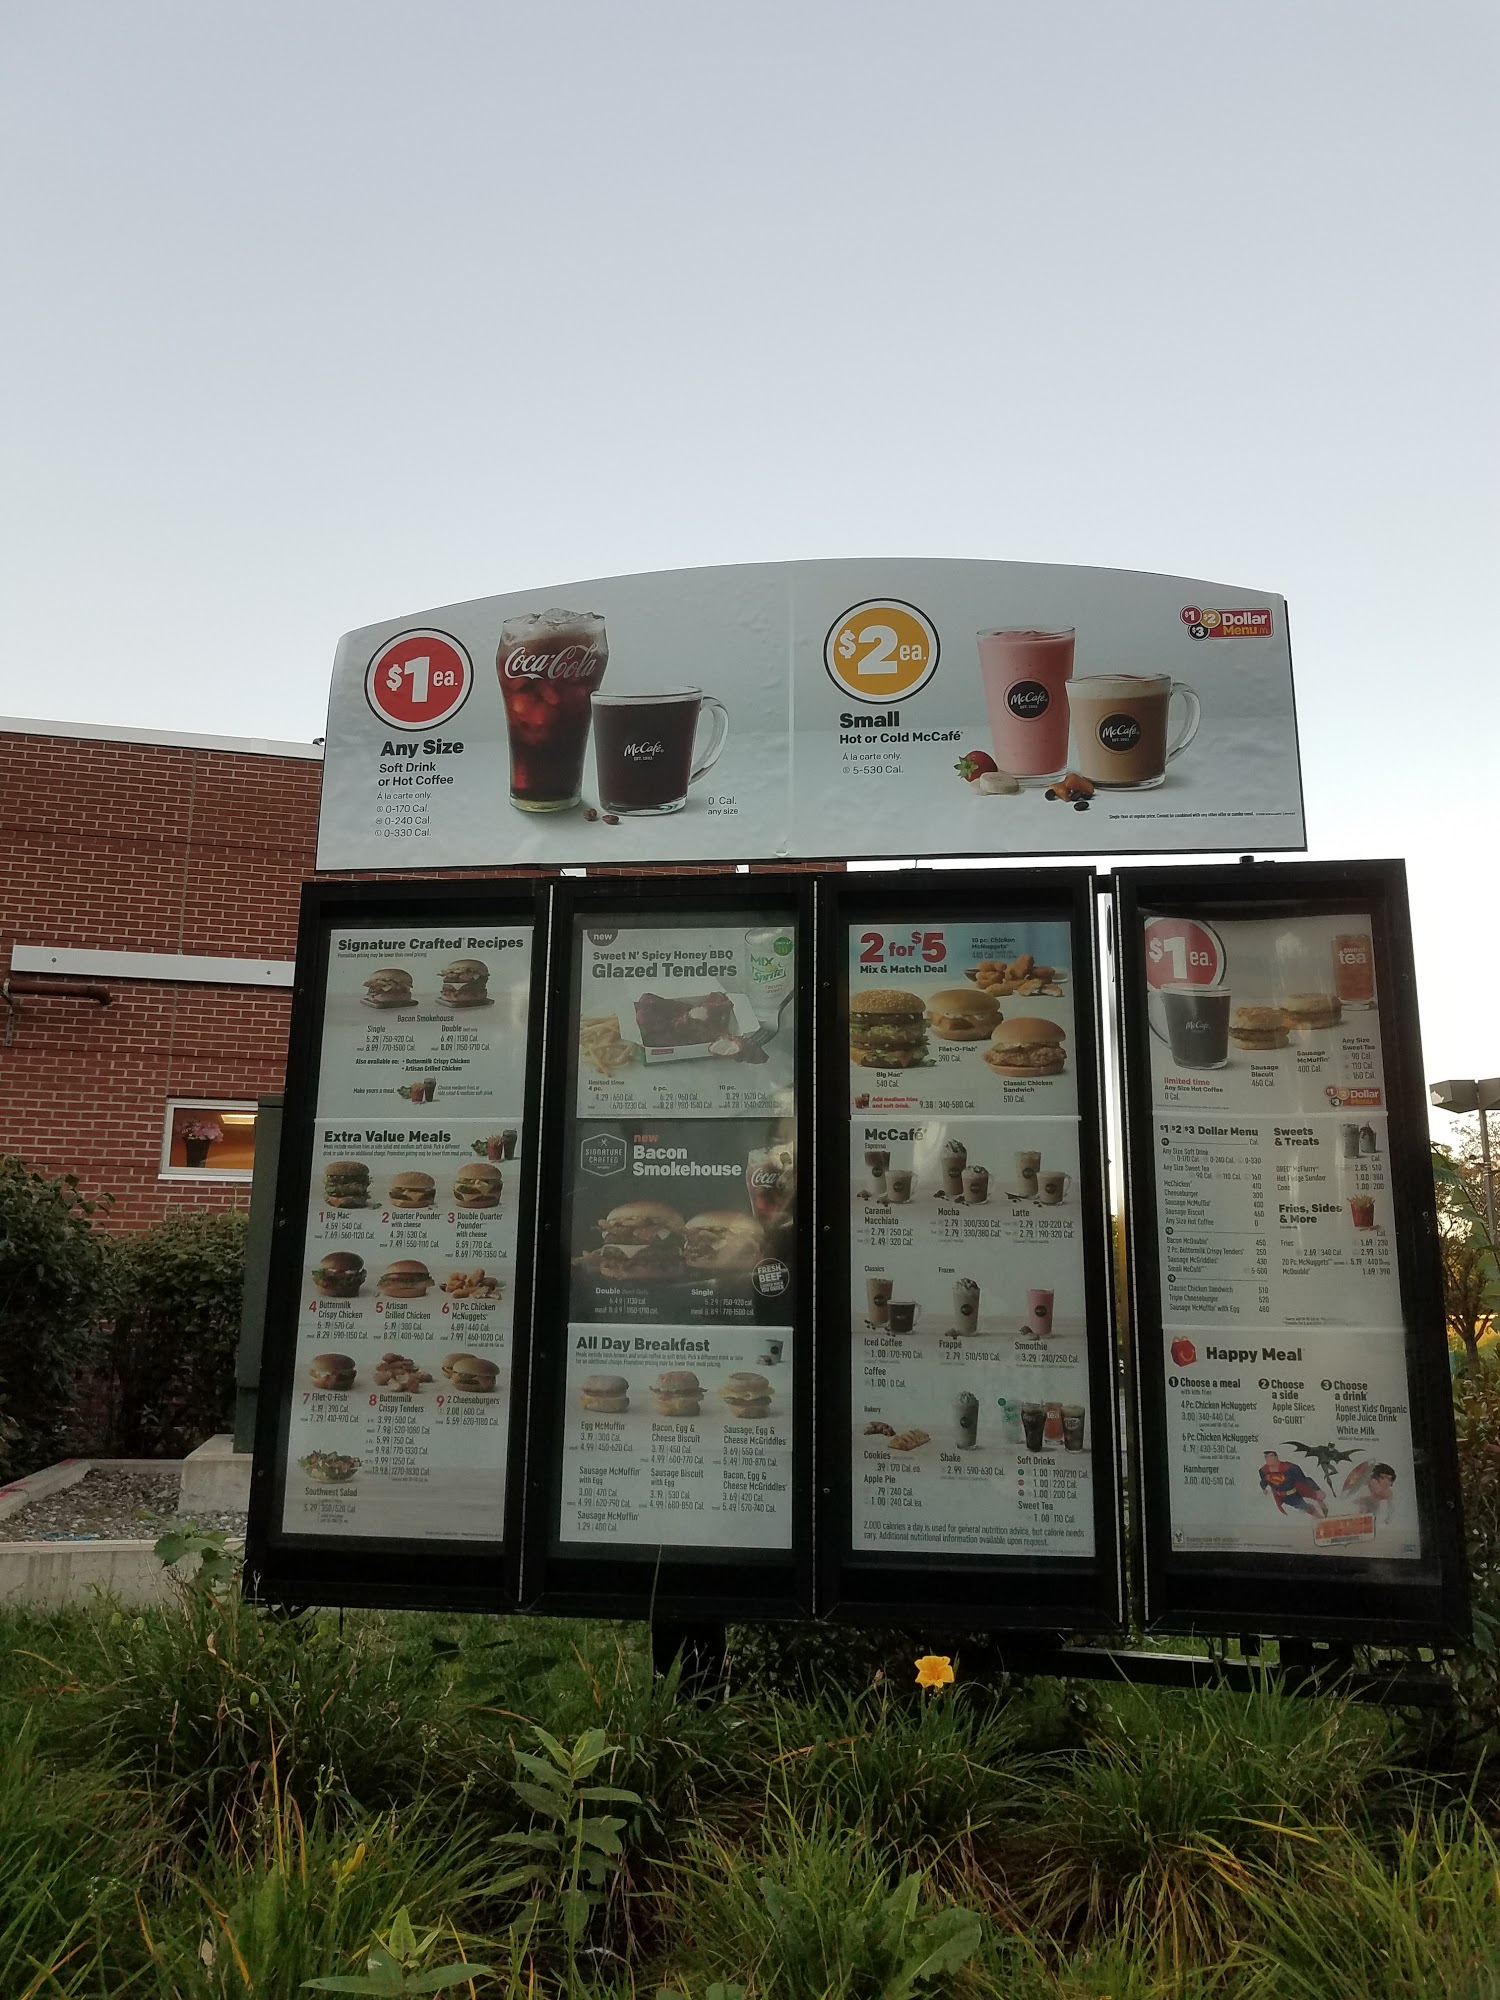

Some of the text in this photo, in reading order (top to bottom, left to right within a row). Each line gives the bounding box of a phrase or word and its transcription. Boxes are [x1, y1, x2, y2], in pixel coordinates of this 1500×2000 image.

[1185, 610, 1195, 621] $1
[1204, 614, 1216, 624] $2
[1222, 612, 1267, 625] Dollar
[1192, 626, 1204, 636] $3
[1223, 626, 1257, 635] Menu
[839, 624, 927, 676] $2 ea.
[503, 643, 601, 680] Coca-Cola
[385, 656, 459, 703] $1 ea.
[1010, 691, 1047, 705] McCafé
[839, 710, 900, 729] Small
[1102, 724, 1139, 739] McCafé
[839, 731, 961, 744] Hot or Cold McCafé
[380, 738, 464, 758] Any Size
[624, 740, 665, 757] McCafé
[851, 753, 859, 761] la
[861, 753, 880, 761] carte
[882, 752, 902, 762] only.
[379, 762, 437, 773] Soft Drink
[853, 764, 904, 775] 5-530 Cal.
[393, 776, 413, 785] Hot
[416, 775, 454, 785] Coffee
[415, 791, 432, 800] only.
[708, 795, 737, 806] 0 Cal.
[385, 804, 429, 813] 0-170 Cal.
[707, 806, 739, 817] any size
[385, 816, 432, 825] 0-240 Cal.
[384, 828, 432, 837] 0-330 Cal.
[338, 937, 524, 952] Signature Crafted Recipes
[860, 930, 946, 963] 2 for $5
[593, 950, 733, 961] Sweet N' Spicy Honey BBQ
[1149, 936, 1212, 979] $1 ea.
[1338, 952, 1366, 965] tea
[592, 963, 737, 978] Glazed Tenders
[860, 964, 947, 973] Mix & Match Deal
[753, 968, 784, 982] Sprite
[398, 1015, 415, 1023] Bacon
[367, 1025, 385, 1033] Single
[1164, 1077, 1192, 1085] limited
[1350, 1088, 1379, 1099] Dollar
[865, 1127, 924, 1141] McCafé
[1160, 1125, 1169, 1134] $1
[1198, 1126, 1228, 1135] Dollar
[1231, 1127, 1258, 1136] Menu
[1274, 1127, 1313, 1136] Sweets
[324, 1130, 451, 1142] Extra Value Meals
[633, 1134, 658, 1143] new
[1275, 1137, 1319, 1146] & Treats
[634, 1146, 688, 1159] Bacon
[633, 1162, 742, 1176] Smokehouse
[864, 1207, 892, 1215] Caramel
[938, 1208, 960, 1216] Mocha
[1012, 1209, 1030, 1217] Latte
[1279, 1204, 1342, 1213] Fries, Sides
[319, 1212, 324, 1223] 1
[326, 1212, 336, 1220] Big
[382, 1213, 389, 1223] 2
[392, 1212, 414, 1221] Quarter
[480, 1213, 503, 1221] Quarter
[864, 1217, 899, 1225] Macchiato
[1280, 1215, 1317, 1224] & More
[758, 1265, 781, 1274] FRESH
[758, 1273, 782, 1282] BEEF
[691, 1288, 714, 1296] Single
[309, 1301, 351, 1312] 4 Buttermilk
[376, 1302, 407, 1313] 5 Artisan
[442, 1303, 495, 1314] 6 Chicken
[318, 1311, 362, 1319] Crispy Chicken
[576, 1337, 710, 1352] All Day Breakfast
[864, 1338, 903, 1347] Iced Coffee
[1014, 1342, 1048, 1350] Smoothie
[1206, 1347, 1302, 1363] Happy Meal
[864, 1367, 886, 1376] Coffee
[1180, 1377, 1210, 1387] Choose
[1220, 1378, 1240, 1388] meal
[1271, 1380, 1304, 1389] Choose
[1334, 1380, 1368, 1391] Choose
[303, 1393, 310, 1404] 7
[369, 1394, 412, 1406] 8 Buttermilk
[1272, 1390, 1299, 1400] a side
[1335, 1391, 1367, 1401] a drink
[437, 1395, 444, 1407] 9
[453, 1396, 500, 1405] Cheeseburgers
[1195, 1401, 1219, 1410] Chicken
[379, 1404, 424, 1413] Crispy Tenders
[1272, 1403, 1315, 1412] Apple Slices
[1335, 1404, 1407, 1414] Honest Organic
[581, 1422, 625, 1430] Egg McMuffin
[652, 1424, 688, 1433] Bacon, Egg
[724, 1425, 768, 1435] Sausage, Egg
[1337, 1426, 1375, 1435] White Milk
[652, 1434, 701, 1443] Cheese Biscuit
[724, 1436, 785, 1445] Cheese McGriddles
[864, 1451, 891, 1460] Cookies
[940, 1453, 961, 1462] Shake
[1017, 1456, 1055, 1466] Soft Drinks
[579, 1466, 639, 1476] Sausage McMuffin
[651, 1468, 704, 1478] Sausage Biscuit
[864, 1475, 895, 1484] Apple Pie
[305, 1488, 357, 1497] Southwest Salad
[1018, 1501, 1053, 1510] Sweet Tea
[883, 1523, 905, 1531] calories
[982, 1527, 1008, 1535] nutrition
[943, 1534, 977, 1543] information
